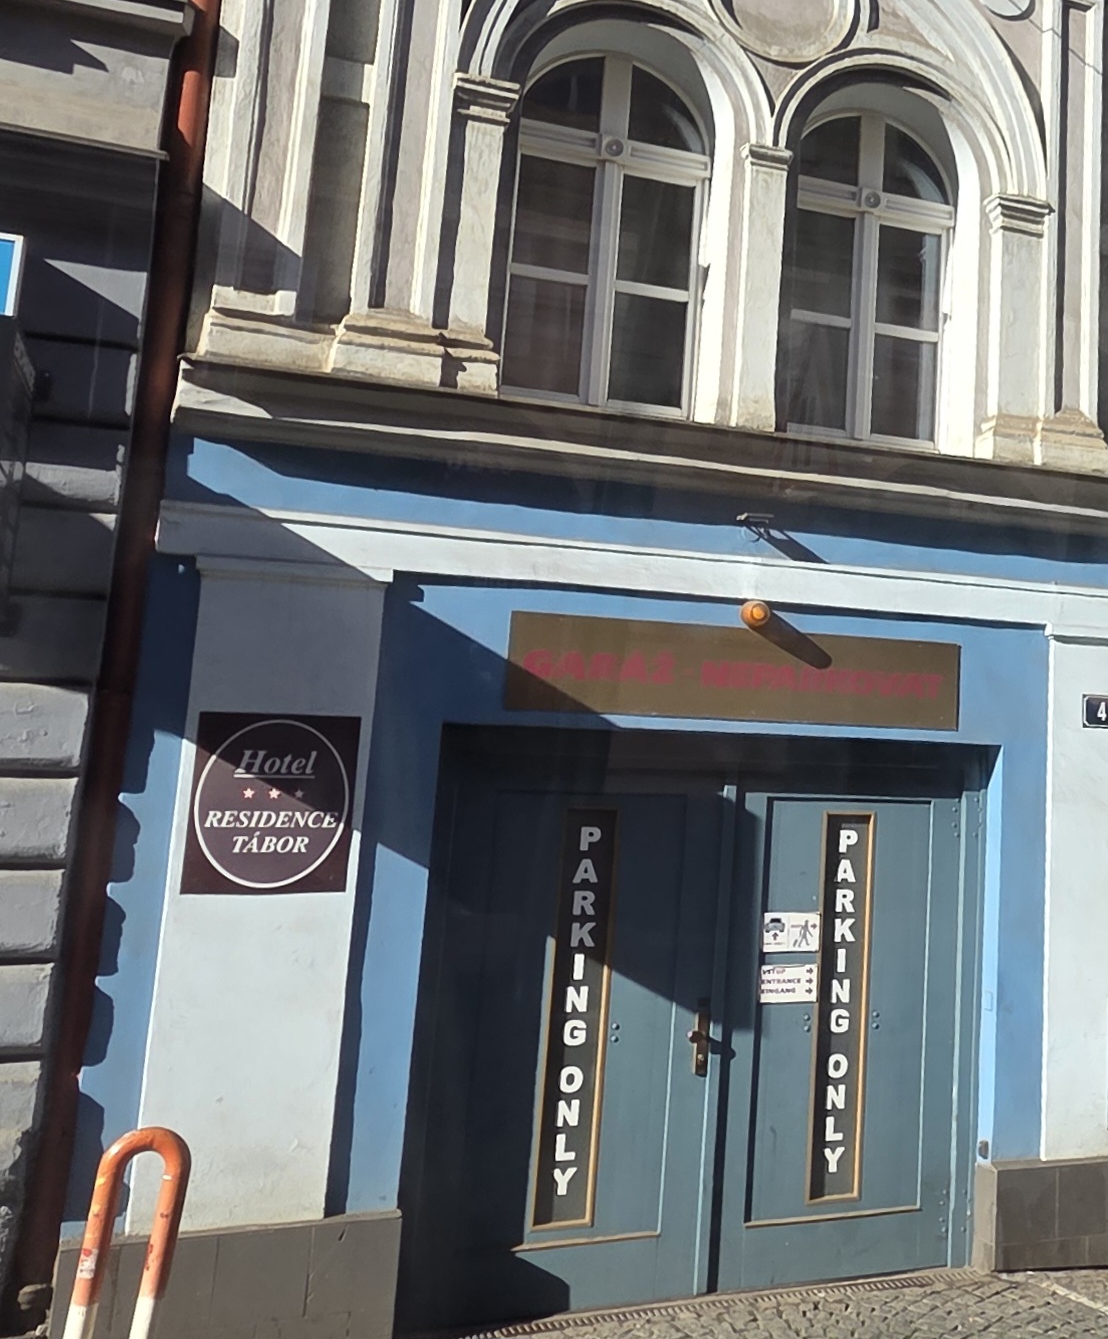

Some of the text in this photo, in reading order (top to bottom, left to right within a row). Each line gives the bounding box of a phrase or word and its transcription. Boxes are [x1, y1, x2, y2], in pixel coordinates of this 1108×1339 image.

[1096, 701, 1108, 722] 4
[234, 750, 318, 775] Hotel
[204, 810, 338, 829] RESIDENCE
[232, 831, 309, 853] TÁBOR
[552, 826, 602, 1196] PARKING ONLY
[823, 829, 859, 1173] PARKING ONLY
